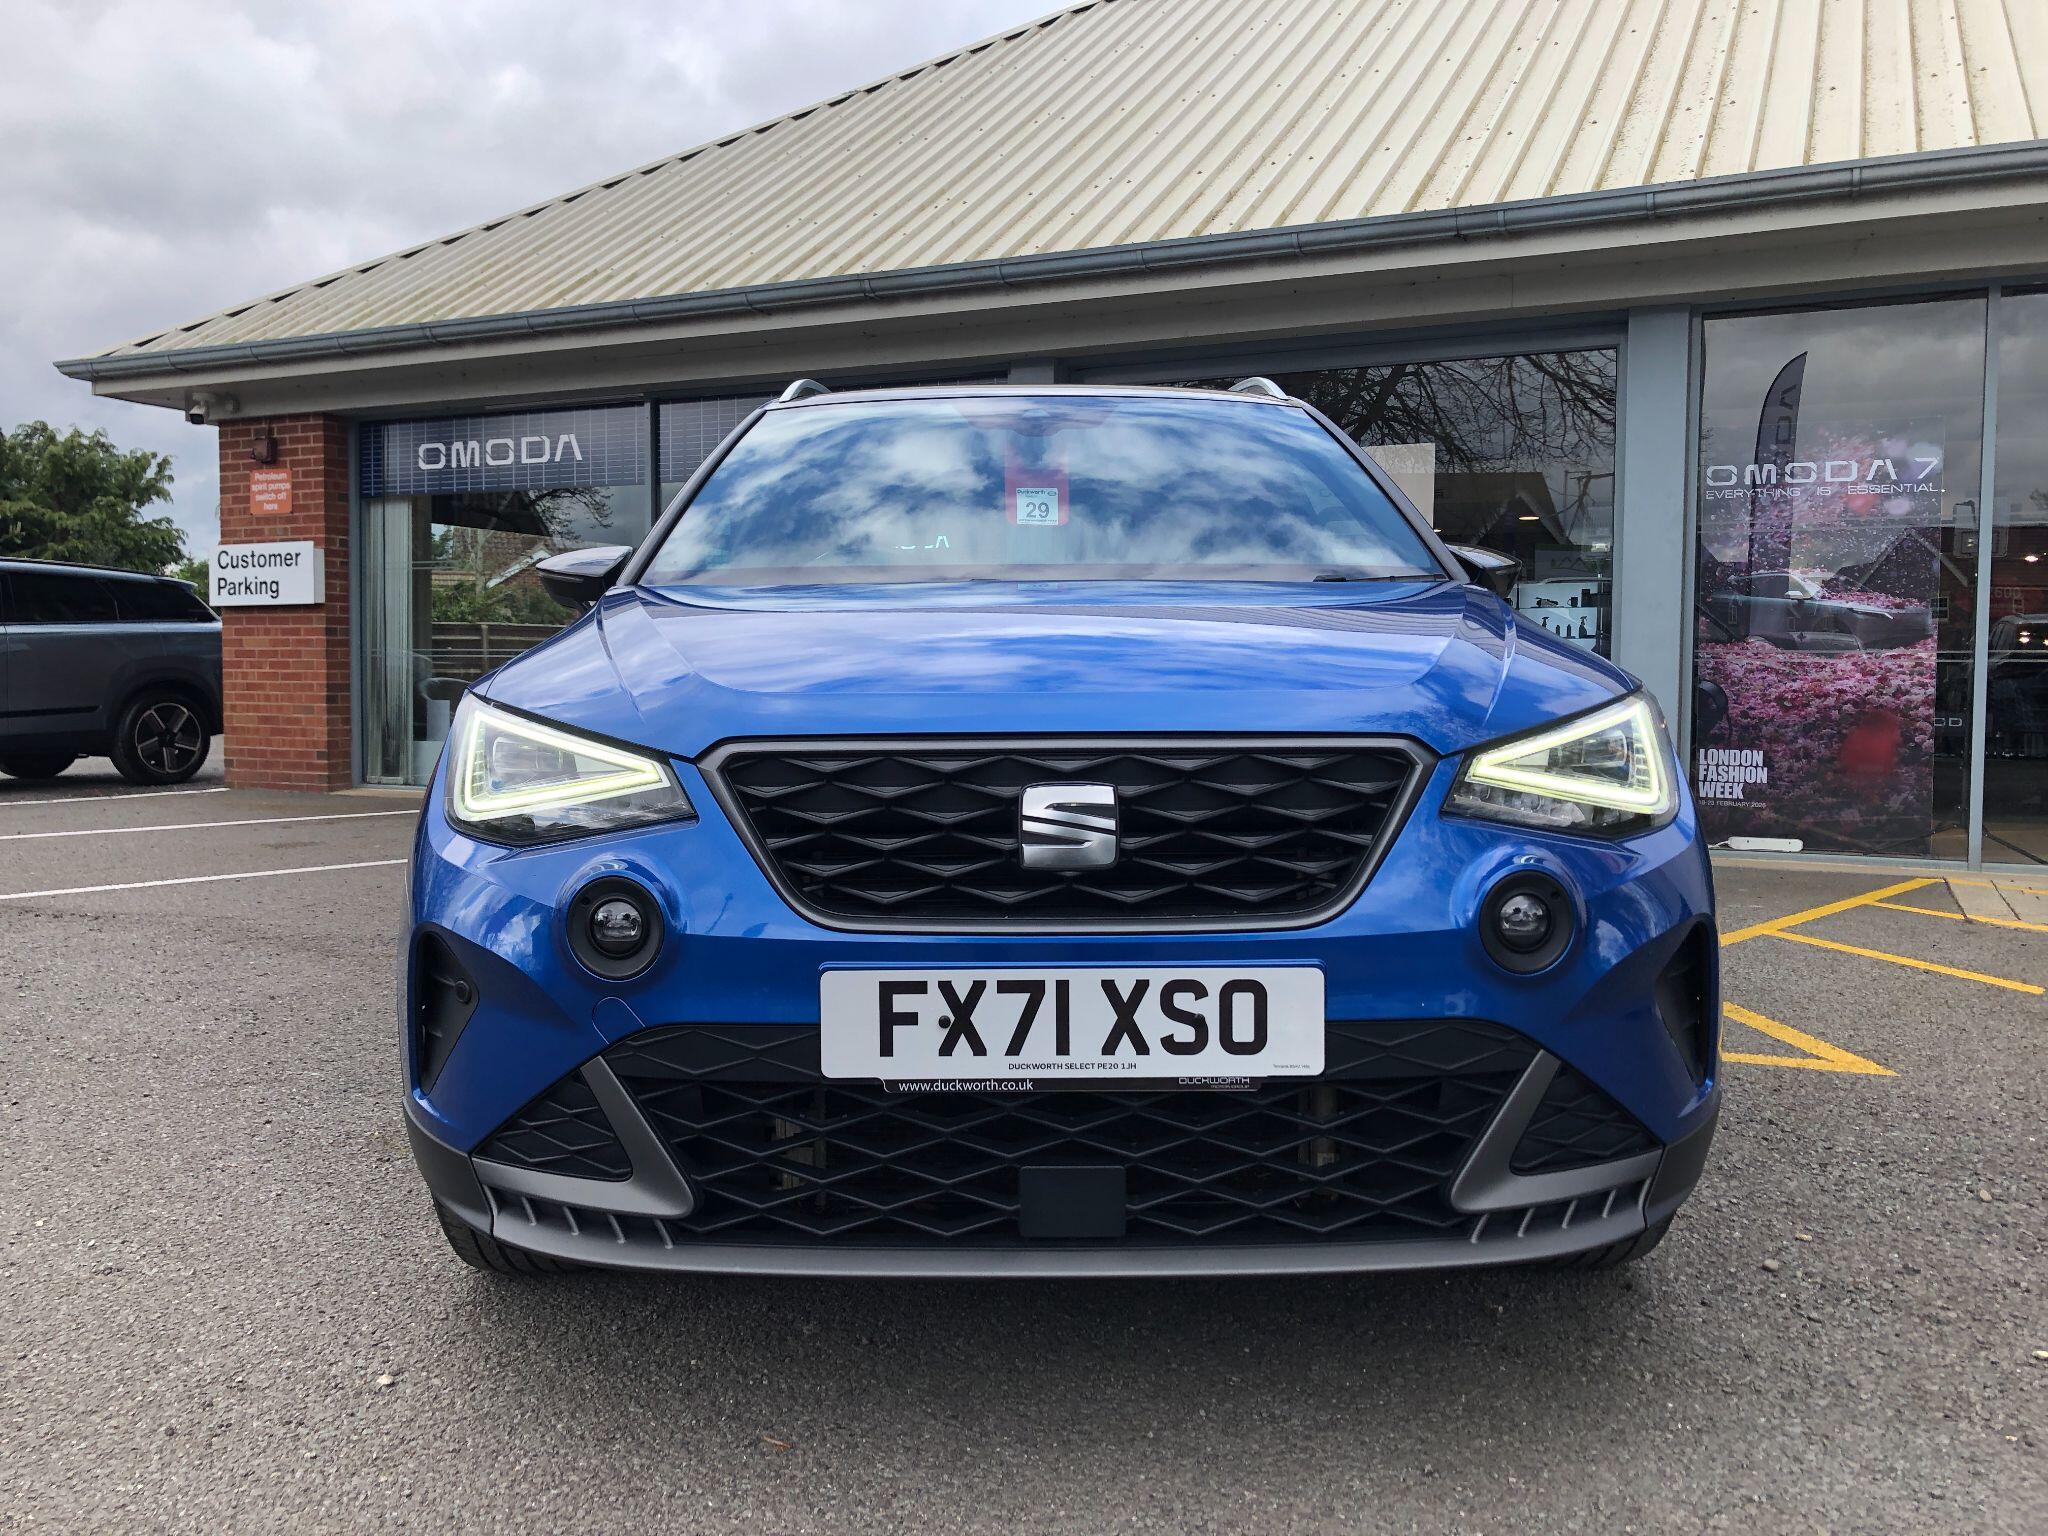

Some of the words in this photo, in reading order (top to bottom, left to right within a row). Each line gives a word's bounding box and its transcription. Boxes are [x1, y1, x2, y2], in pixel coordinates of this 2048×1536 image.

[418, 433, 583, 470] OMODA
[1706, 458, 1897, 486] OMODA
[1914, 457, 1939, 479] 7
[1706, 487, 1801, 500] EVERYTHING
[1816, 486, 1831, 496] IS
[1026, 502, 1049, 518] 29
[217, 550, 301, 569] Customer
[217, 576, 279, 599] Parking
[1699, 748, 1763, 766] LONDON
[1699, 765, 1768, 783] FASHION
[1699, 781, 1744, 799] WEEK
[879, 979, 1070, 1057] FX71
[1100, 978, 1268, 1056] XSO
[1064, 1062, 1095, 1070] SELECT
[1097, 1062, 1119, 1070] PE20
[1121, 1062, 1137, 1070] 1JH
[898, 1079, 1034, 1092] www.duckworth.co.uk
[1178, 1077, 1250, 1085] DUCKWORTH
